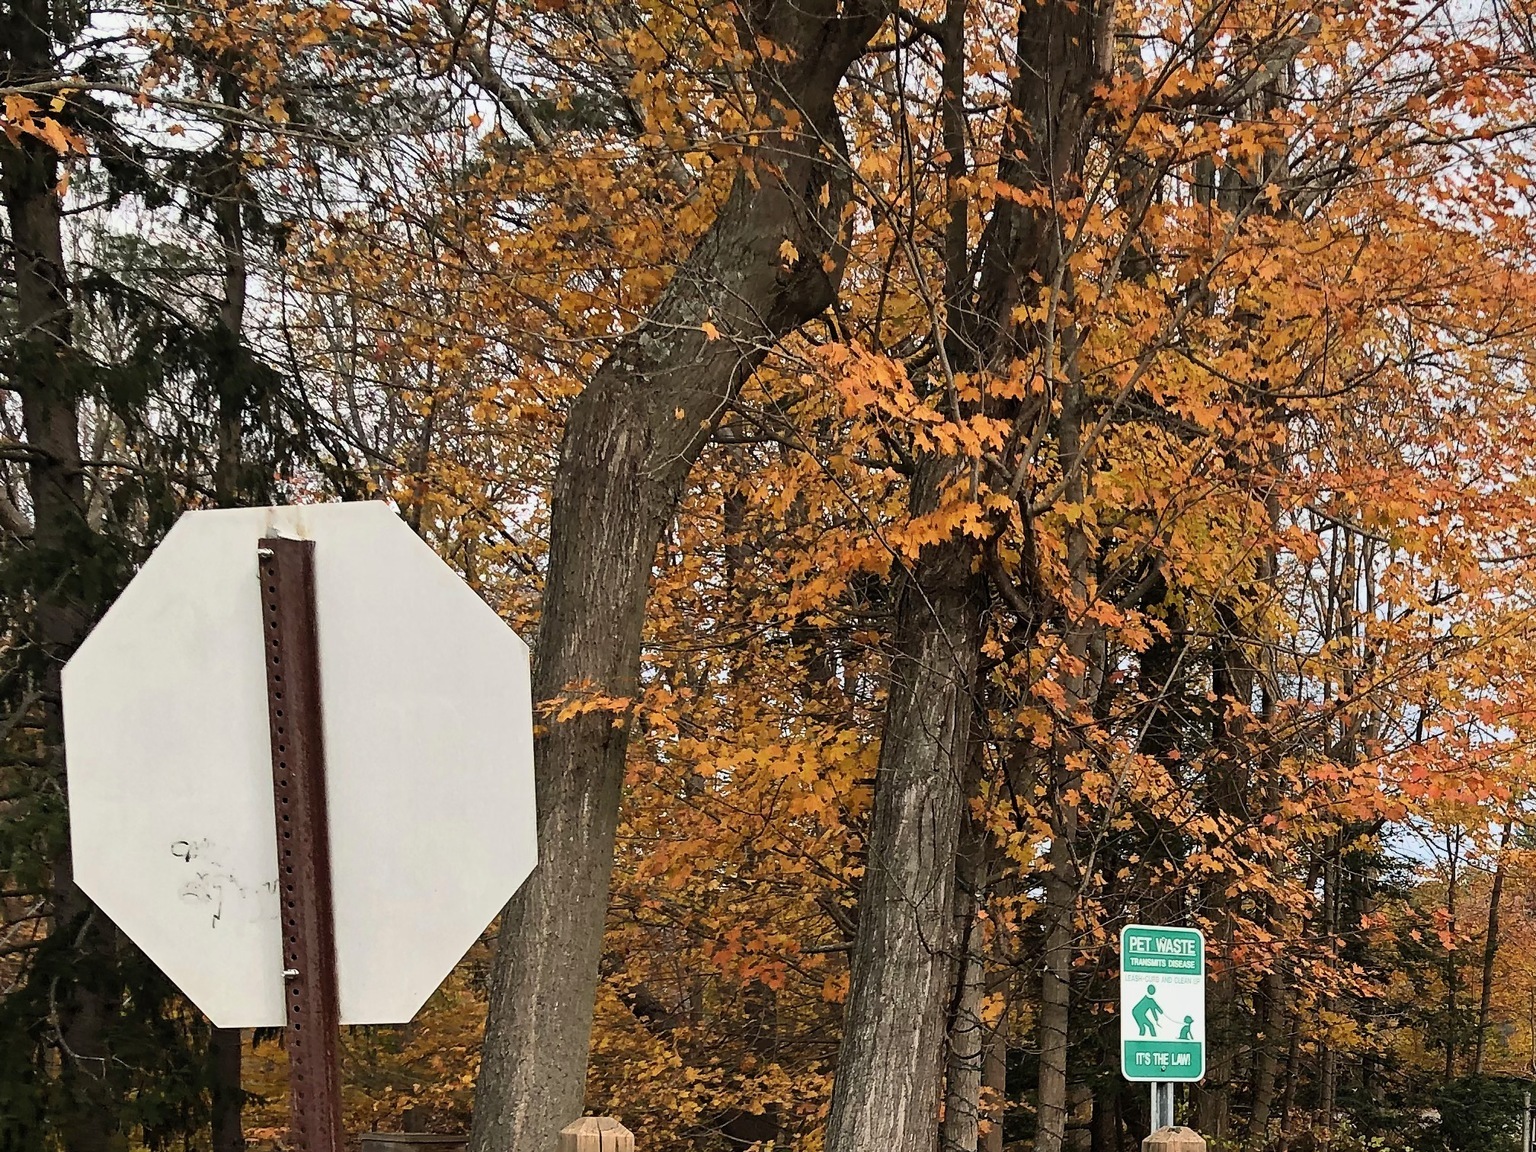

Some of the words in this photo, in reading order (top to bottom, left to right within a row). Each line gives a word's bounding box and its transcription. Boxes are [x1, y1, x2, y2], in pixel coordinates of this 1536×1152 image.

[1129, 936, 1152, 951] PET
[1156, 937, 1196, 954] WASTE
[1130, 957, 1167, 967] TRANSMITS
[1168, 959, 1195, 969] DISEASE
[1161, 976, 1173, 984] AND
[1174, 977, 1192, 985] CLEAN
[1135, 1052, 1151, 1066] IT'S
[1152, 1052, 1169, 1067] THE
[1171, 1053, 1191, 1067] LAW!
